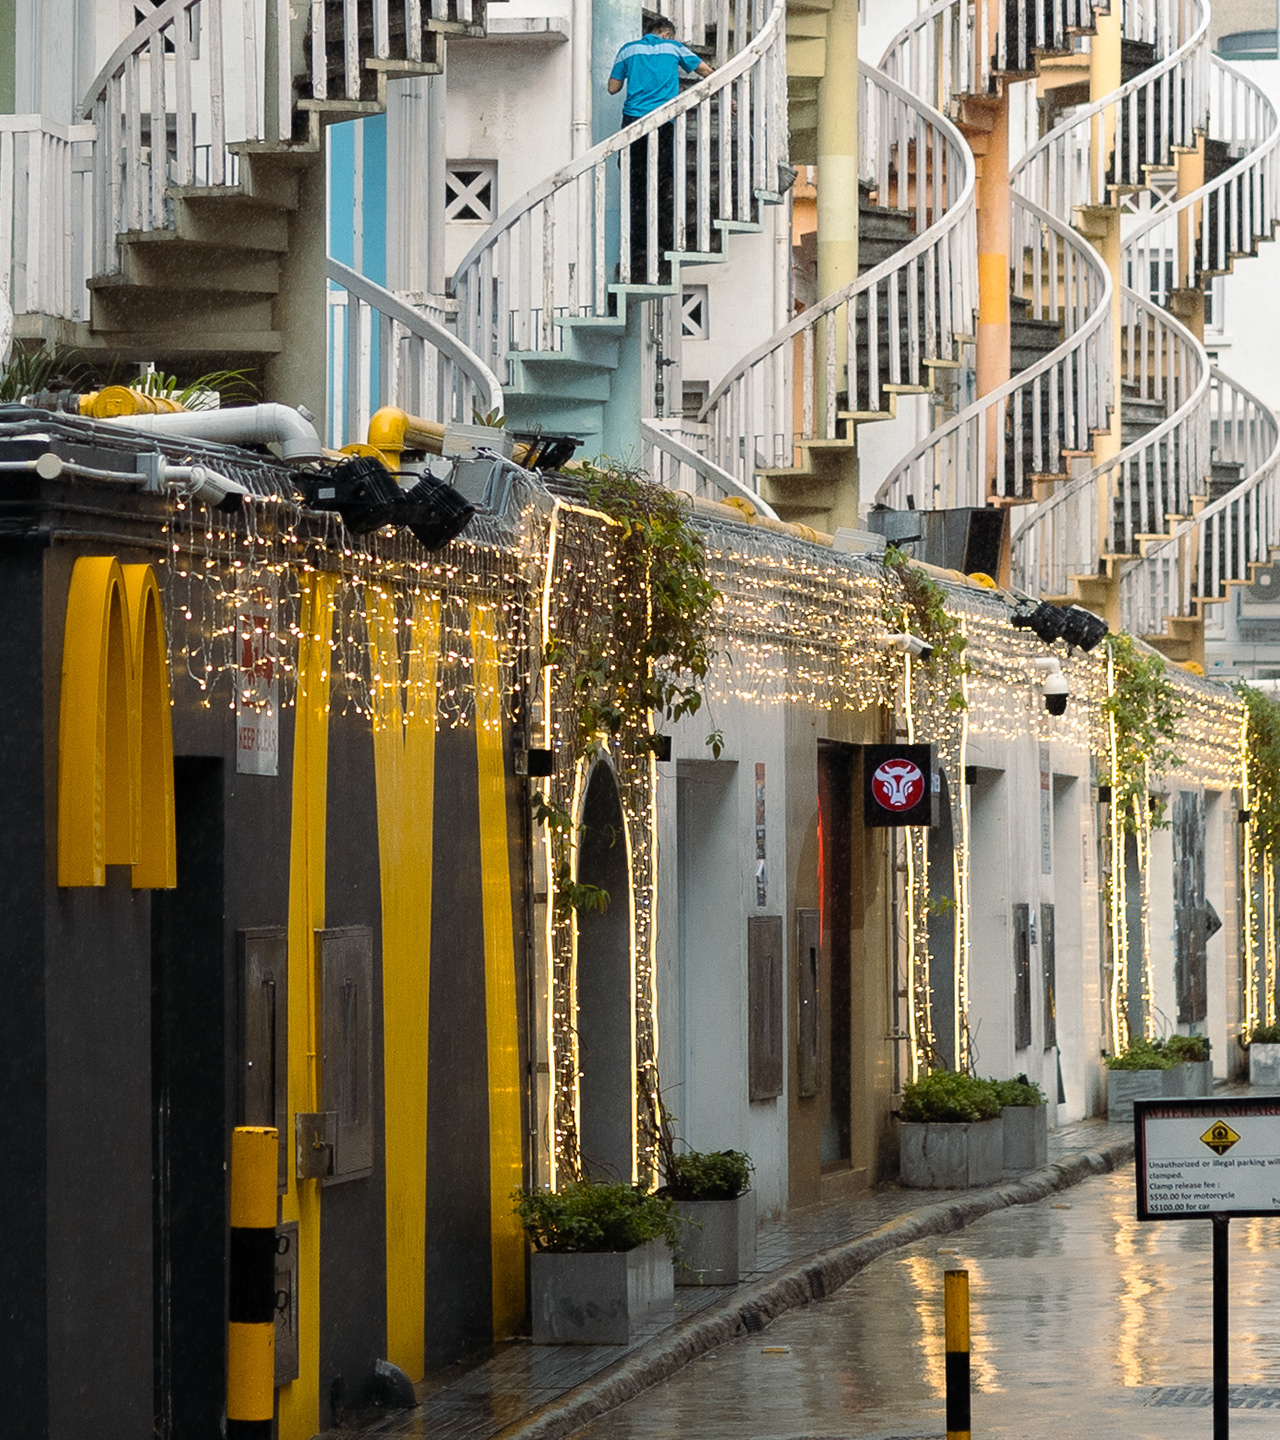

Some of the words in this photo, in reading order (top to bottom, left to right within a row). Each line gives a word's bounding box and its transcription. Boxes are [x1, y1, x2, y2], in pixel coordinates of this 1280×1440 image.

[239, 727, 255, 750] KEEP
[1148, 1161, 1200, 1169] Unauthorized
[1212, 1159, 1235, 1168] illegal
[1237, 1158, 1266, 1168] parking
[1148, 1171, 1184, 1180] clamped.
[1149, 1182, 1174, 1191] Clamp
[1174, 1182, 1202, 1190] release
[1203, 1181, 1216, 1189] fee
[1180, 1192, 1192, 1200] for
[1193, 1191, 1236, 1200] motorcycle
[1185, 1202, 1197, 1210] for
